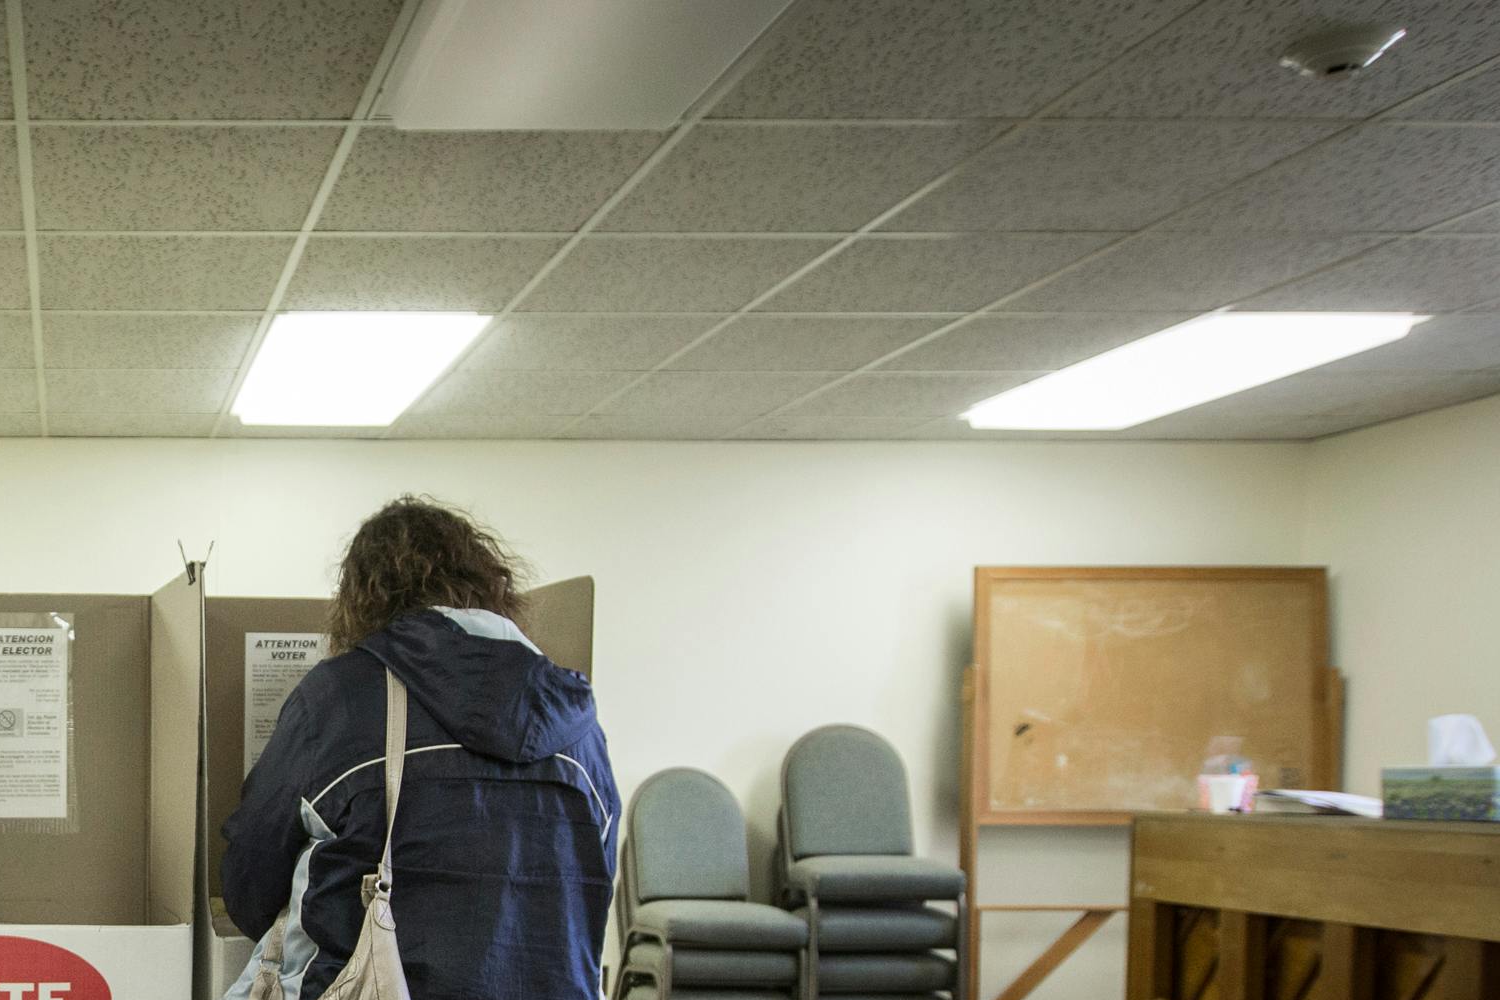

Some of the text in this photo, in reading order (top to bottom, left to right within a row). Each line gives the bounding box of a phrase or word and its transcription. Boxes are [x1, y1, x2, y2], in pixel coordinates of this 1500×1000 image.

[255, 639, 318, 648] ATTENTION
[1, 646, 53, 655] ELECTOR
[271, 651, 307, 660] VOTER
